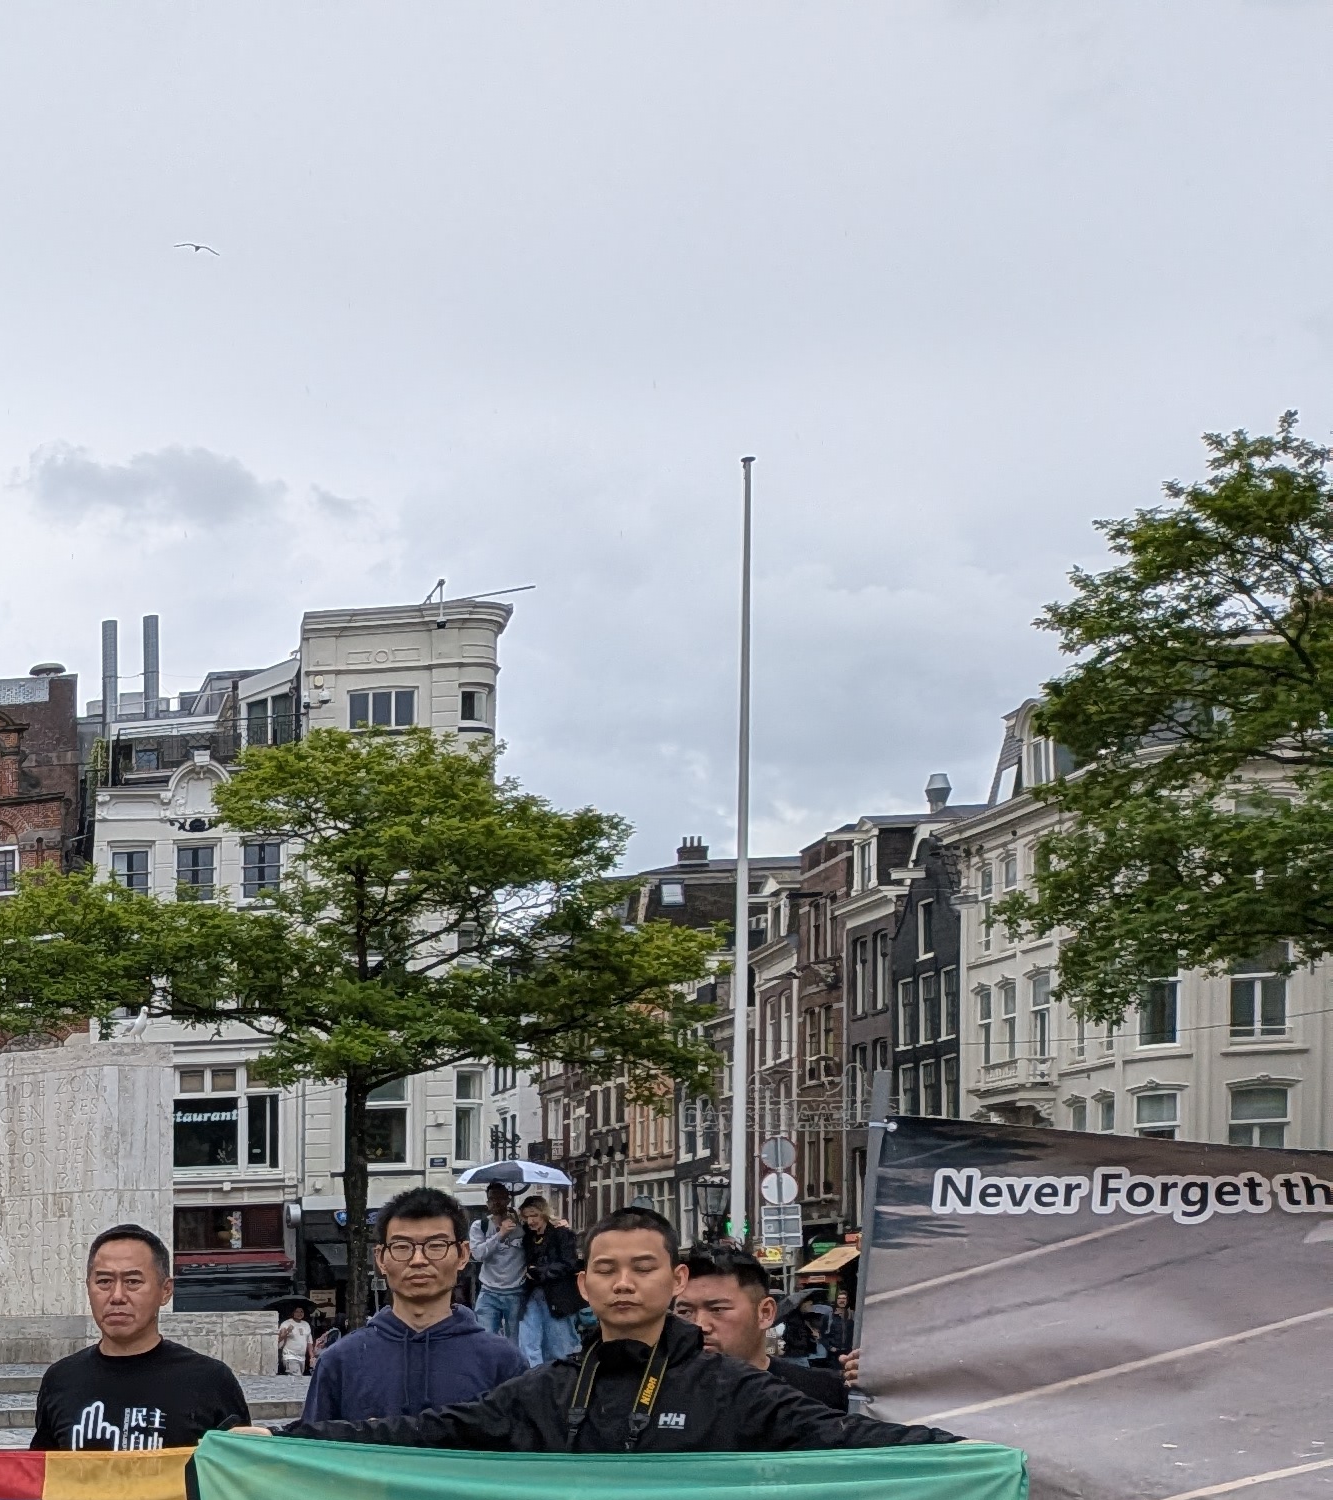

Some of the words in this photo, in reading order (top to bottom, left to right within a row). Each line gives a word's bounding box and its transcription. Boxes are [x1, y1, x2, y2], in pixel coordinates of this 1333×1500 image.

[939, 1173, 1082, 1208] Never
[1098, 1173, 1264, 1218] Forget
[1280, 1176, 1333, 1207] th
[639, 1376, 658, 1406] Nikon
[130, 1407, 167, 1430] 民主
[658, 1412, 686, 1426] HH
